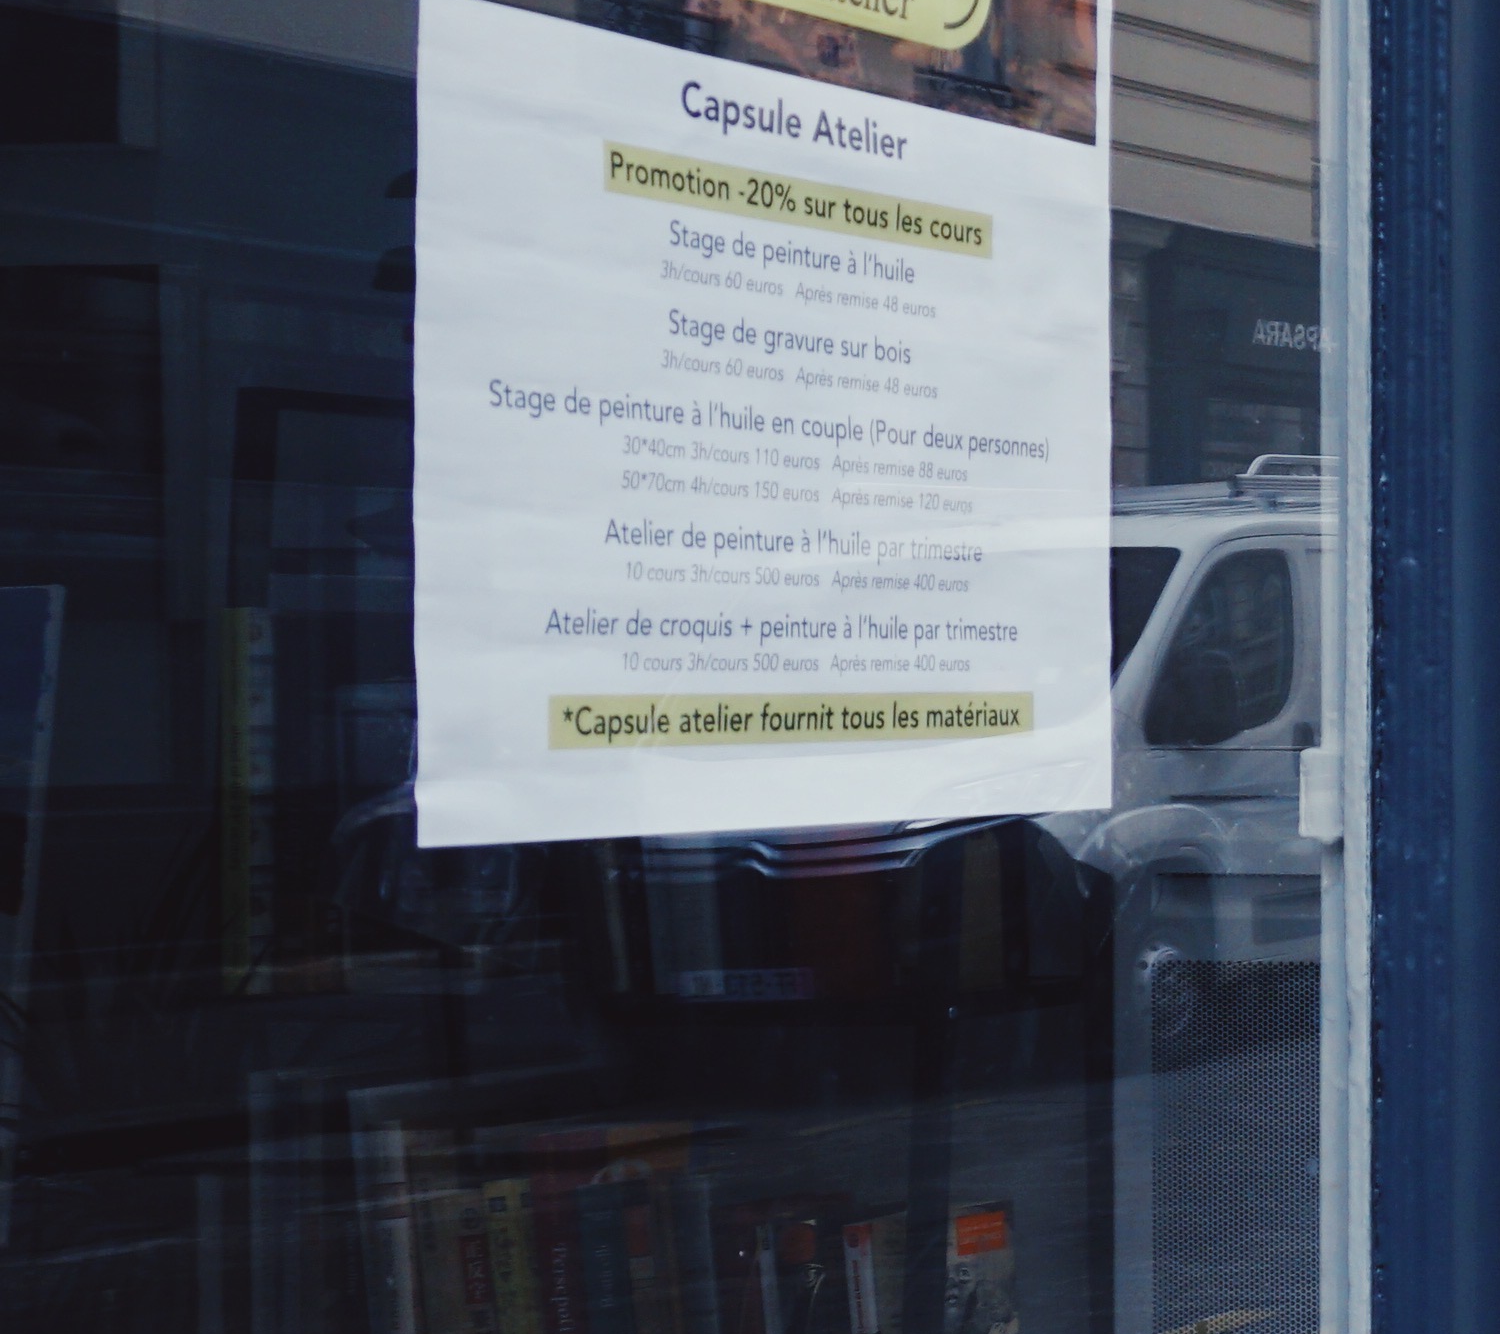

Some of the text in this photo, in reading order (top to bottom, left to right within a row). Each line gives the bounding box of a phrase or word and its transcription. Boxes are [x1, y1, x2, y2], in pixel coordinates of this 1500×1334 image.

[680, 80, 908, 161] Capsule Atelier
[609, 149, 984, 247] Promotion -20% sur tous les cours
[669, 218, 726, 259] Stage
[731, 230, 757, 260] de
[762, 239, 842, 273] peinture
[846, 249, 857, 276] à
[659, 258, 937, 320] 3h/cours 60 euros Après remise 48 euros
[668, 307, 912, 366] Stage de gravure sur bois
[660, 348, 939, 401] 3h/cours 60 euros Après remise 48 euros
[488, 378, 557, 419] Stage
[563, 386, 592, 417] de
[598, 392, 685, 426] peinture
[690, 399, 702, 427] à
[771, 415, 795, 435] en
[800, 414, 864, 448] couple
[869, 418, 918, 448] (Pour
[922, 422, 964, 451] deux
[967, 435, 1050, 464] personnes)
[690, 440, 751, 466] 3h/cours
[754, 446, 780, 468] 110
[782, 454, 821, 473] euros
[831, 453, 870, 478] Après
[872, 462, 916, 479] remise
[917, 460, 935, 481] 88
[936, 466, 969, 483] euros
[688, 474, 750, 500] 4h/cours
[754, 479, 780, 502] 150
[782, 487, 820, 504] euros
[831, 486, 871, 511] Après
[872, 490, 915, 510] remise
[918, 491, 941, 512] 120
[942, 498, 974, 516] euros
[603, 517, 676, 548] Atelier
[680, 520, 708, 550] de
[712, 524, 795, 559] peinture
[800, 528, 812, 554] à
[876, 540, 905, 567] par
[910, 536, 985, 564] trimestre
[625, 560, 972, 594] 10 cours 3h/cours 500 euros Après remise 400 euros
[544, 606, 620, 637] Atelier
[625, 607, 655, 638] de
[659, 611, 735, 644] croquis
[739, 616, 754, 637] +
[759, 612, 838, 648] peinture
[842, 614, 853, 640] à
[913, 623, 941, 649] par
[944, 616, 1019, 643] trimestre
[622, 650, 971, 677] 10 cours 3h/cours 500 euros Après remise 400 euros
[678, 702, 755, 735] atelier
[759, 701, 835, 733] fournit
[840, 705, 886, 731] tous
[892, 699, 920, 730] les
[926, 700, 1022, 729] matériaux
